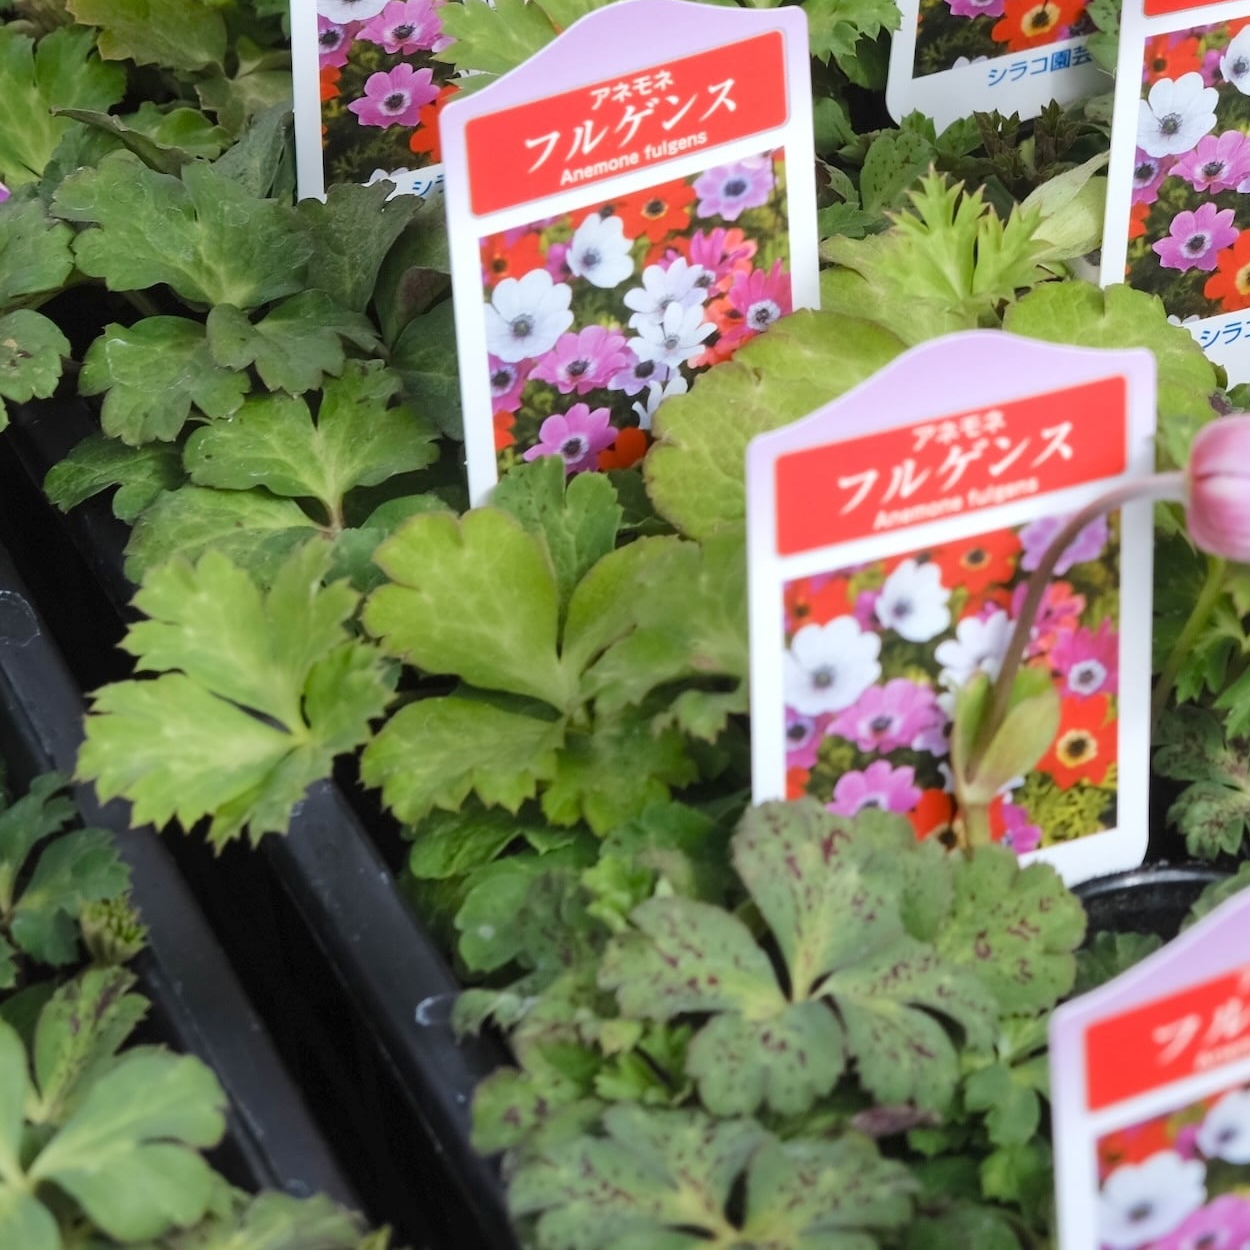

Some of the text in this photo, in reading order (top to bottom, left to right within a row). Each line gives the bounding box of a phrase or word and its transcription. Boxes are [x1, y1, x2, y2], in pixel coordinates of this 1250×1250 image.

[589, 68, 674, 111] アネモネ
[987, 45, 1093, 87] シラコ園芸
[524, 77, 737, 173] フルゲンス
[560, 131, 708, 187] Anemone fulgens
[912, 409, 1005, 451] アネモネ
[838, 422, 1073, 514] フルゲンス
